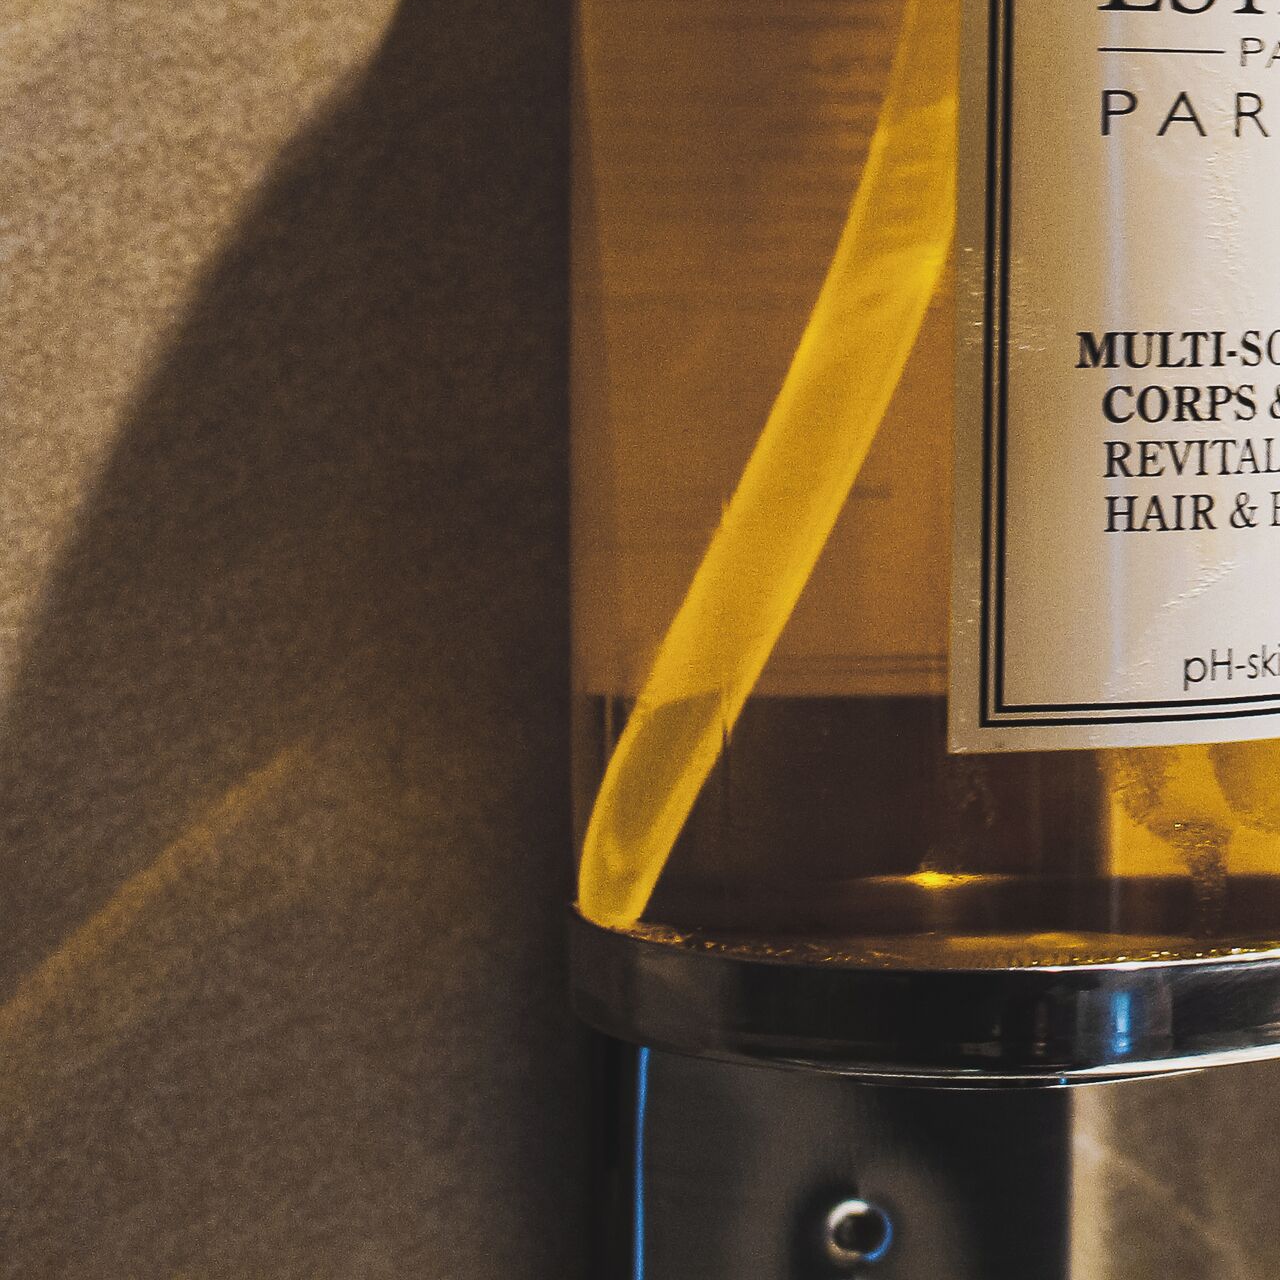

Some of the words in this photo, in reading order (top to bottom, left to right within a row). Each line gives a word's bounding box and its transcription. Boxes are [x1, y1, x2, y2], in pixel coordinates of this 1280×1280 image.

[1102, 384, 1258, 423] CORPS
[1104, 493, 1217, 532] HAIR
[1229, 492, 1259, 529] &
